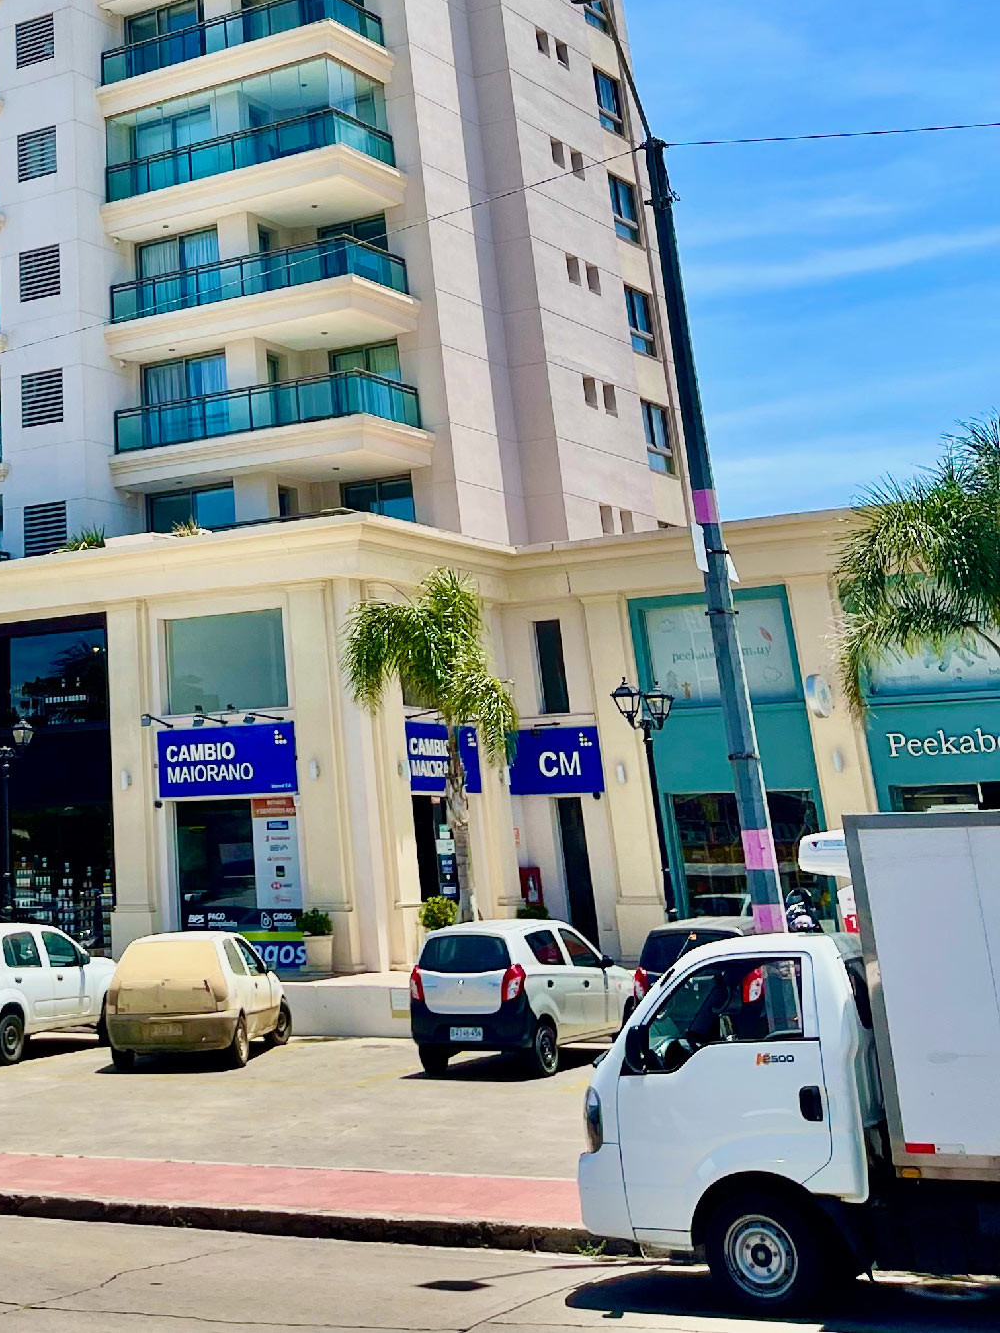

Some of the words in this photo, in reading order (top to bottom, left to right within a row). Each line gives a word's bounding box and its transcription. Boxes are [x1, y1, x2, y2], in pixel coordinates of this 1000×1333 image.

[166, 742, 236, 763] CAMBIO
[167, 762, 254, 784] MAIORANO
[538, 751, 582, 777] CM
